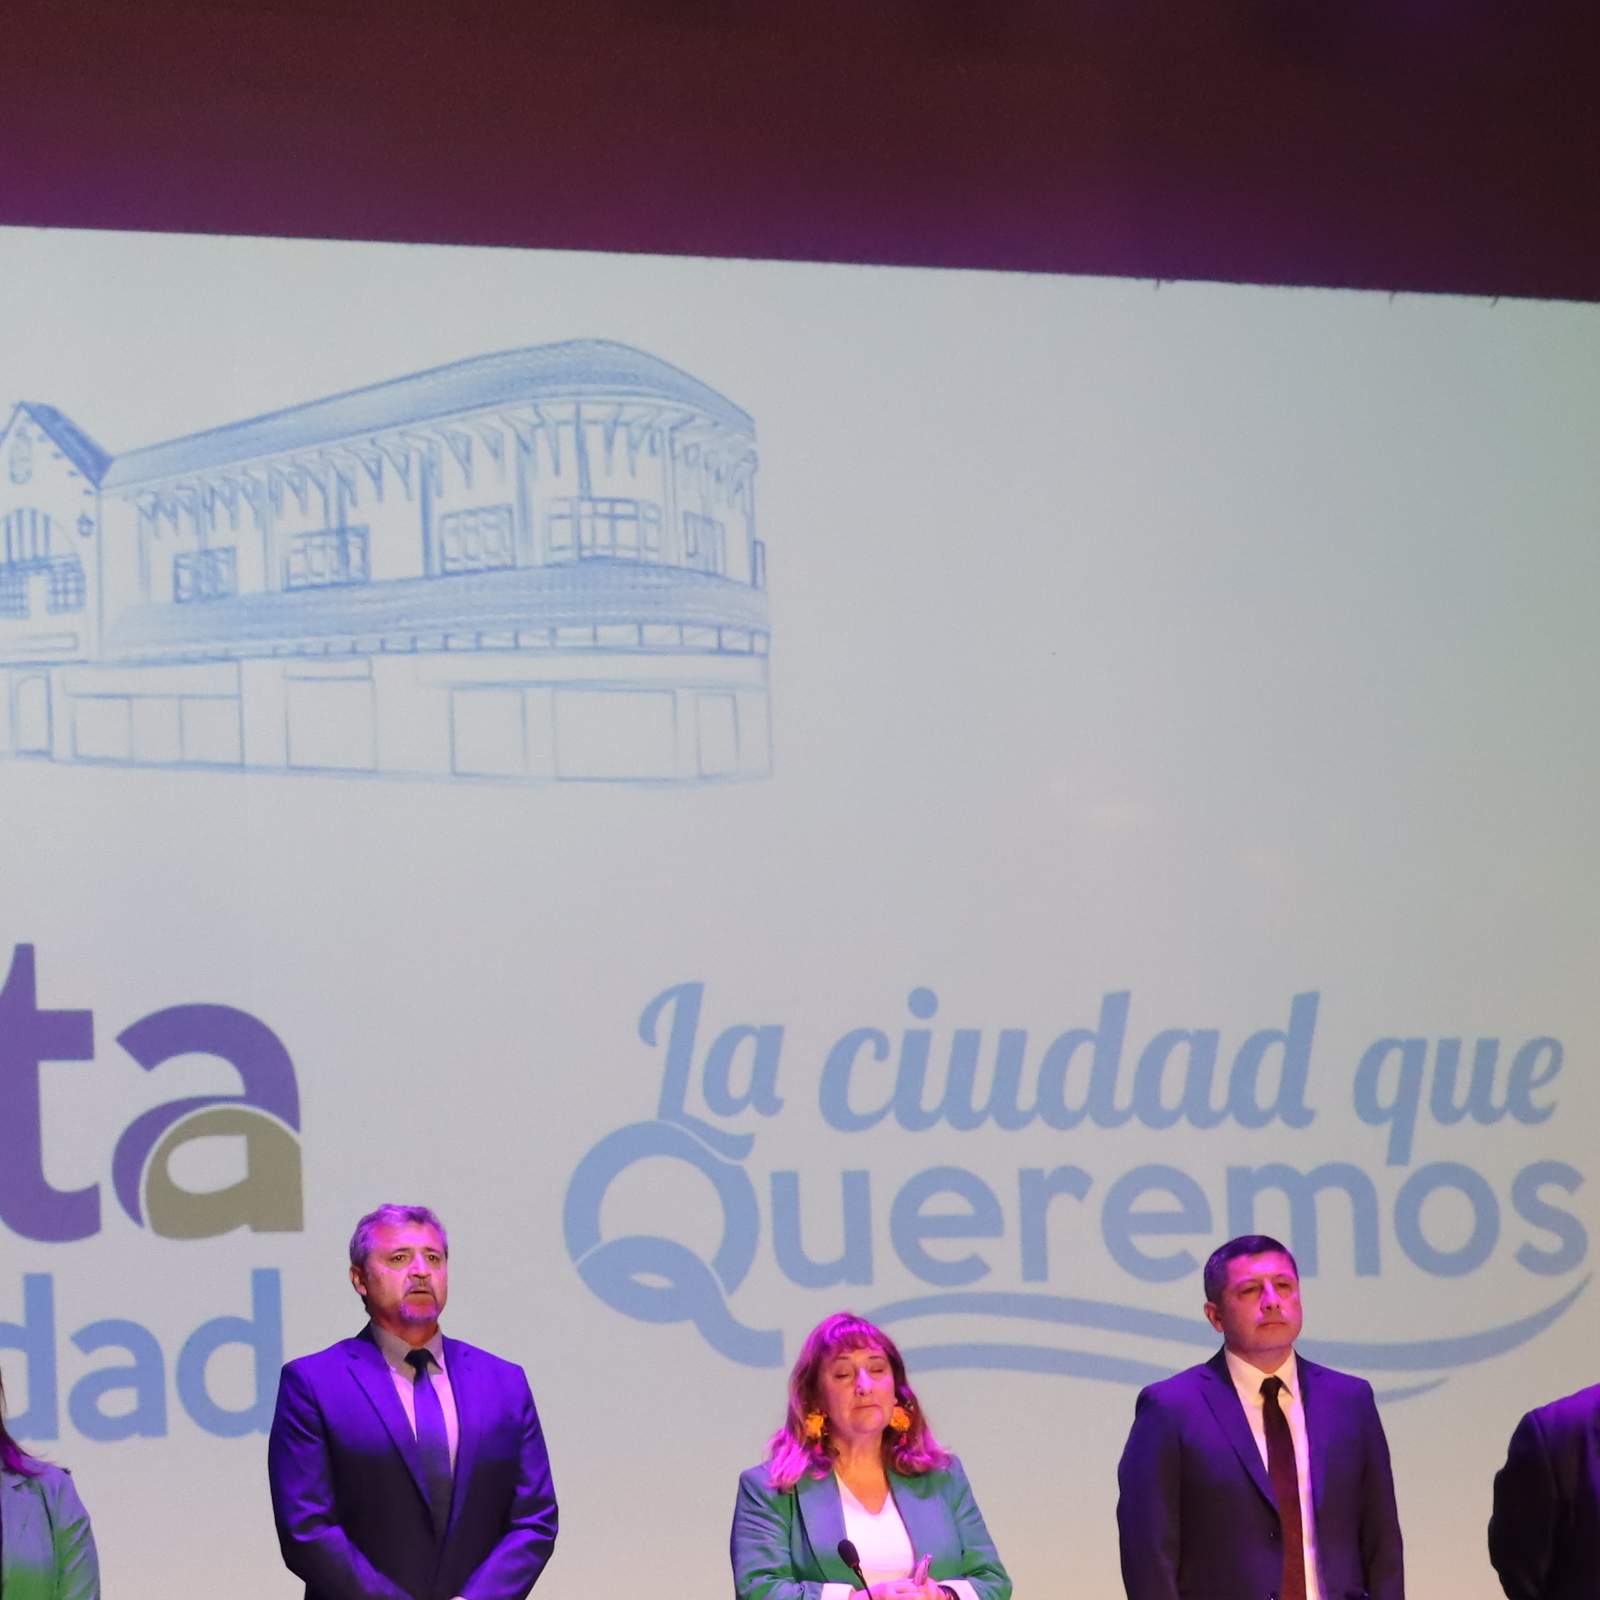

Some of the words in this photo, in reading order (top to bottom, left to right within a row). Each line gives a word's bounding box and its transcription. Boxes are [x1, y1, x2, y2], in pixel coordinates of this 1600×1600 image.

[638, 981, 784, 1160] La
[818, 986, 1321, 1132] ciudad
[1352, 1036, 1564, 1167] que
[562, 1119, 1588, 1367] Queremos
